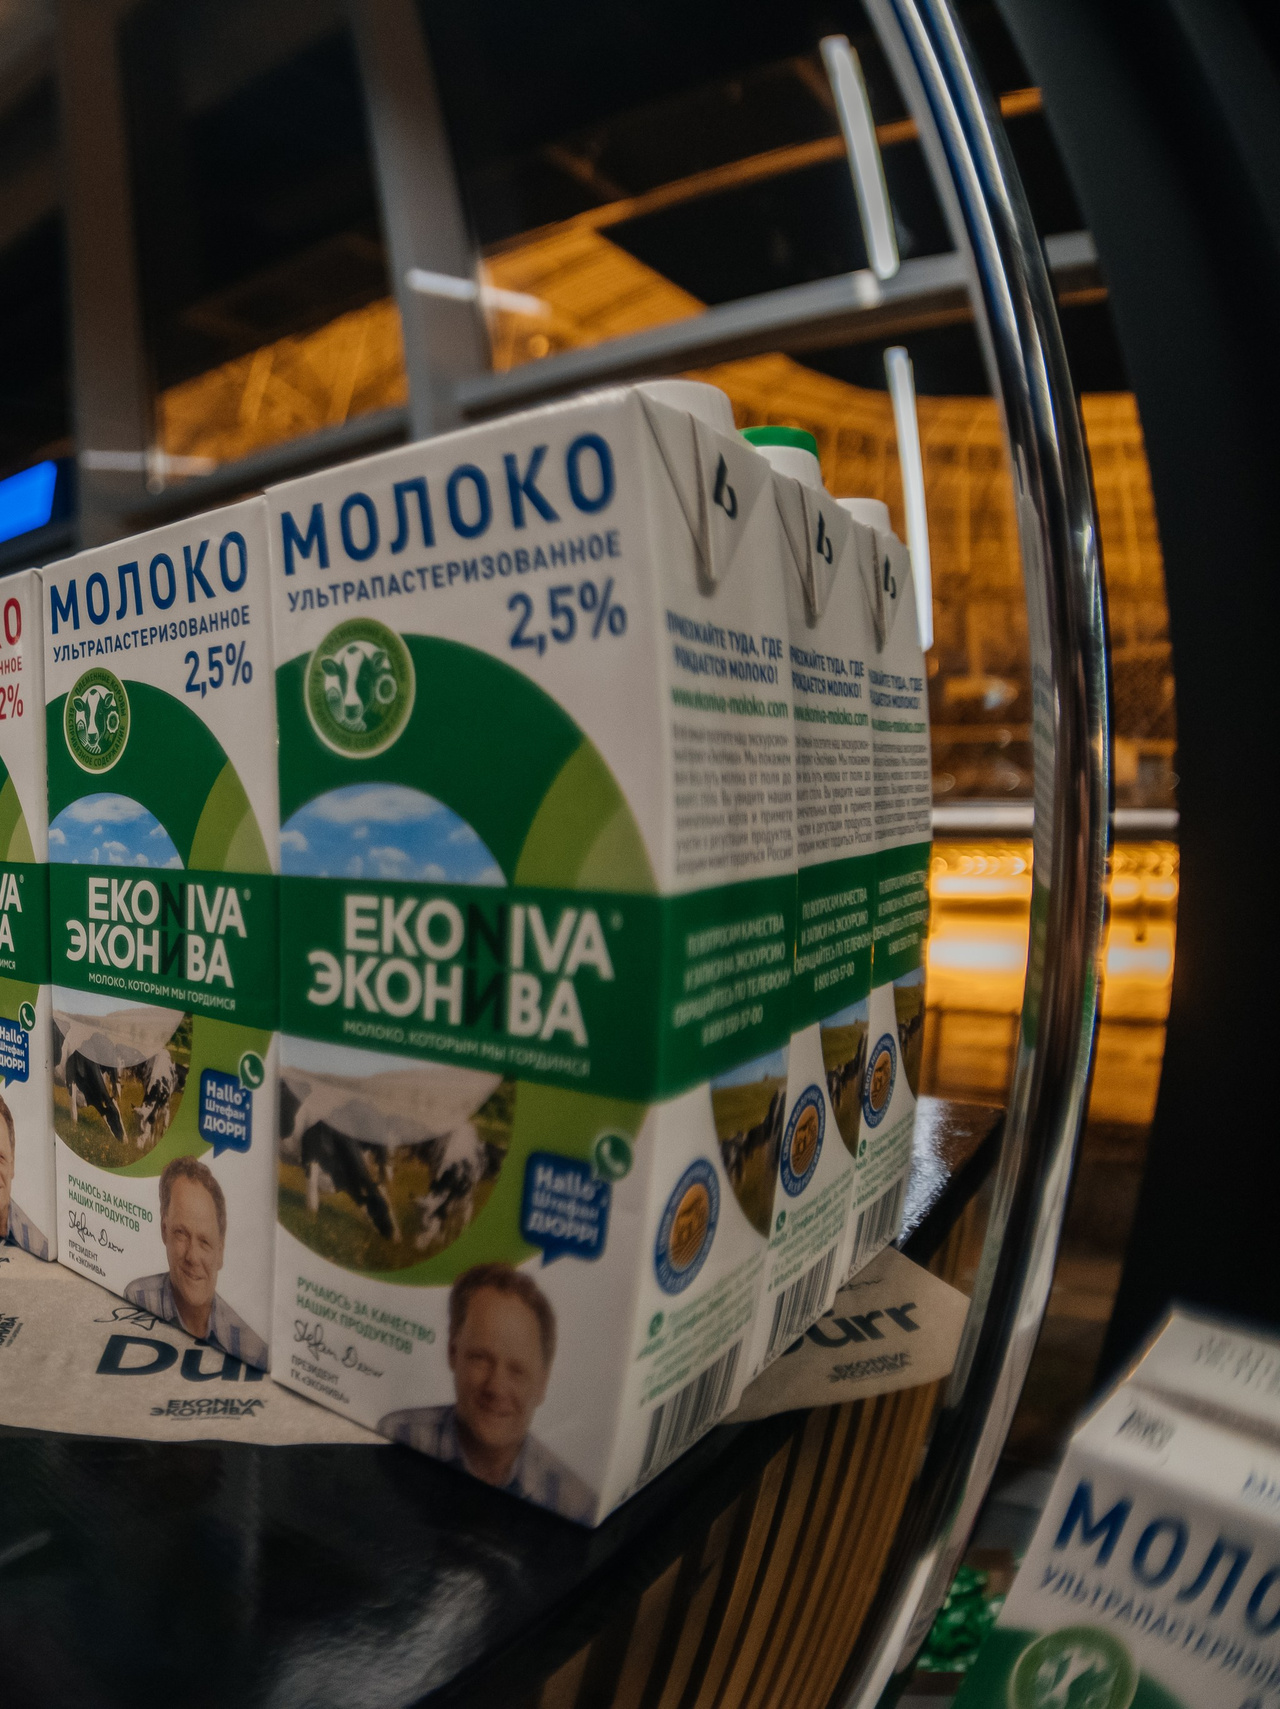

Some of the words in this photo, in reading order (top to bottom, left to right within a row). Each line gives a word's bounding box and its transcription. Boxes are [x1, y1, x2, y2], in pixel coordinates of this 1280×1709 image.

[281, 432, 616, 577] МОЛОКО
[50, 531, 248, 635] МОЛОКО
[287, 529, 622, 613] УЛЬТРАПАСТЕРИЗОВАННОЕ
[53, 605, 251, 664] УЛЬТРАПАСТЕРИЗОВАННОЕ
[506, 577, 628, 658] 2,5%
[727, 629, 760, 658] ТУДА,
[761, 635, 784, 661] ГДЕ
[184, 640, 253, 700] 2,5%
[729, 659, 779, 685] МОЛОКО!
[827, 680, 862, 699] МОЛОКО!
[849, 659, 865, 678] ГДЕ
[88, 877, 248, 939] EKONIVA
[742, 912, 785, 940] КАЧЕСТВА
[65, 919, 235, 989] ЭКОНИВА
[344, 894, 616, 982] EKONIVA
[88, 972, 127, 991] МОЛОКО,
[128, 979, 170, 997] КОТОРЫМ
[171, 988, 186, 1001] МЫ
[187, 989, 236, 1012] ГОРДИМСЯ
[307, 949, 590, 1048] ЭКОНИВА
[343, 1019, 407, 1046] МОЛОКО,
[409, 1029, 479, 1057] КОТОРЫМ
[481, 1040, 506, 1062] МЫ
[508, 1044, 591, 1078] ГОРДИМСЯ
[203, 1114, 247, 1141] ДЮРР!
[205, 1098, 246, 1121] Штефан
[68, 1174, 102, 1199] РУЧАЮСЬ
[102, 1190, 112, 1203] ЗА
[113, 1195, 153, 1223] КАЧЕСТВО
[68, 1189, 94, 1211] НАШИХ
[94, 1202, 140, 1233] ПРОДУКТОВ
[532, 1189, 600, 1219] Штефан
[68, 1239, 98, 1262] ПРЕЗИДЕНТ
[68, 1250, 75, 1260] ГК
[296, 1294, 337, 1322] НАШИХ
[339, 1313, 413, 1355] ПРОДУКТОВ
[297, 1276, 352, 1312] РУЧАЮСЬ
[354, 1300, 368, 1315] ЗА
[371, 1307, 436, 1346] КАЧЕСТВО
[150, 1406, 256, 1418] ЭКОНИВА
[167, 1398, 265, 1410] EKONIVA
